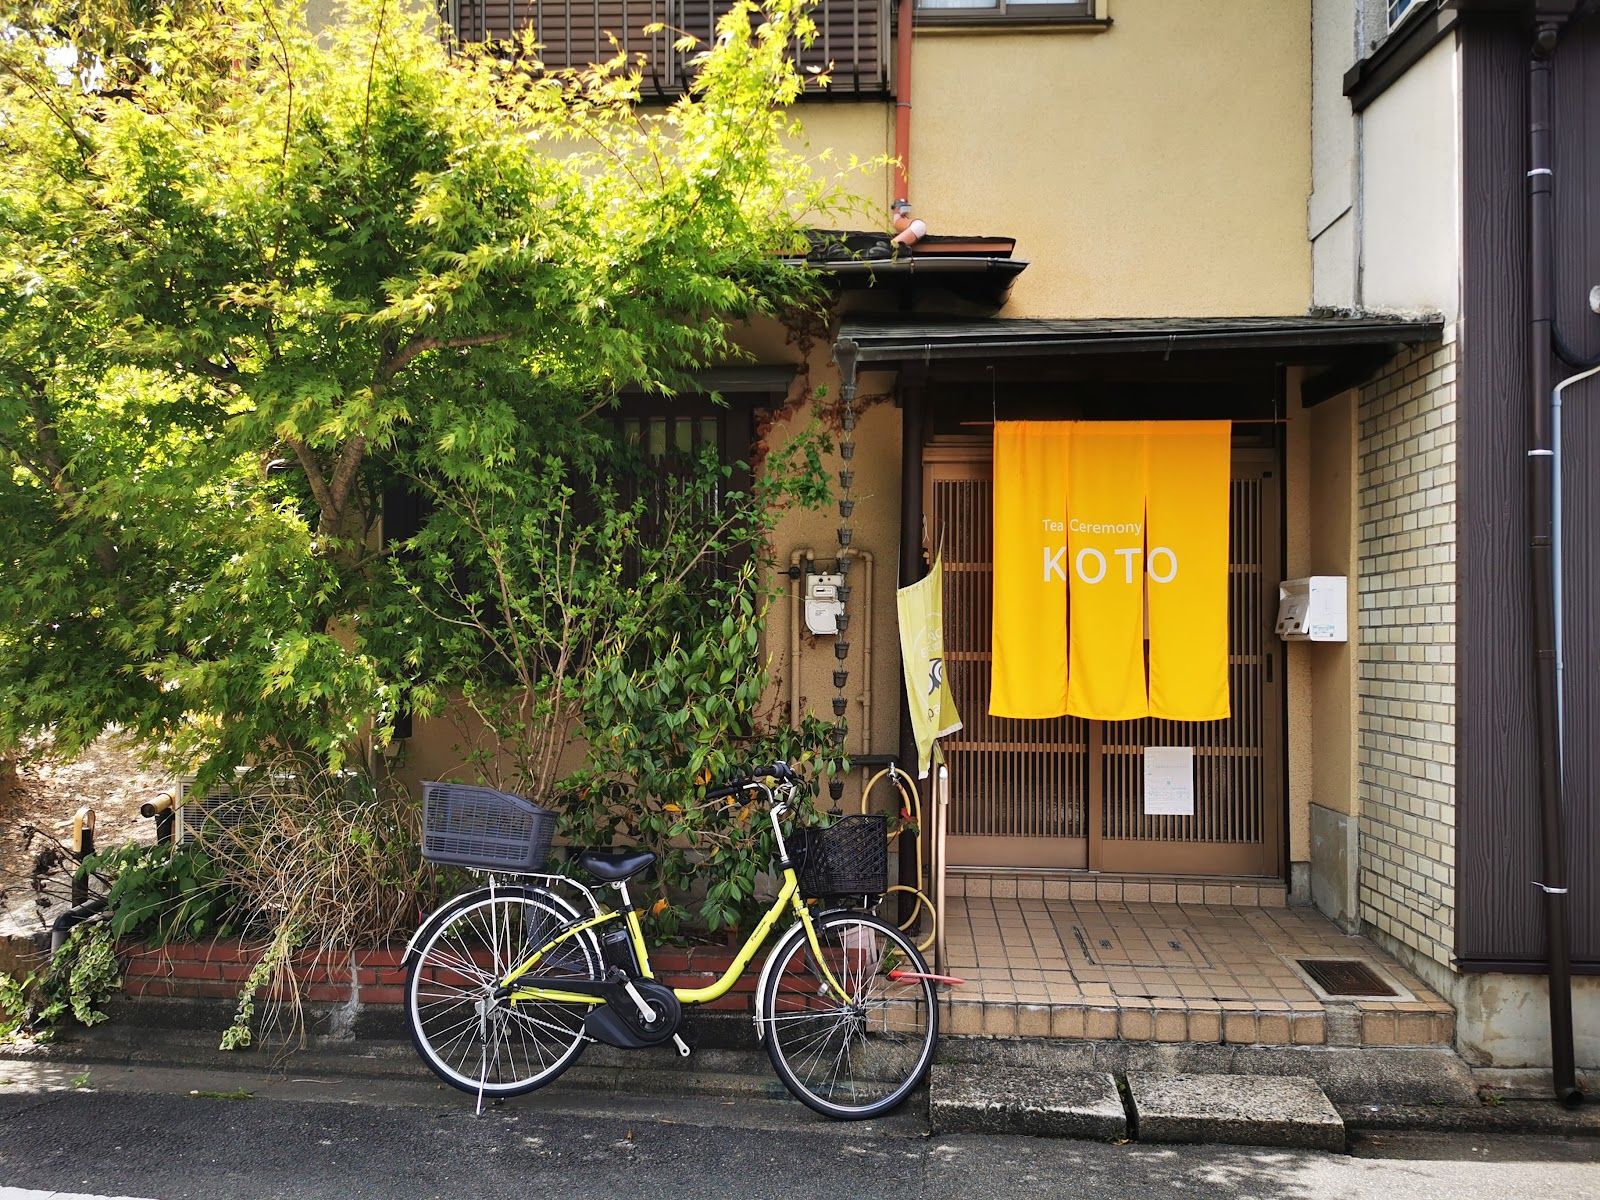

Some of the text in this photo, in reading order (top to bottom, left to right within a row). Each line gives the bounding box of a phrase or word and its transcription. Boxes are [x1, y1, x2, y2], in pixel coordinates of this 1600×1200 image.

[1042, 518, 1142, 535] Tea Ceremony
[1043, 546, 1178, 584] KOTO
